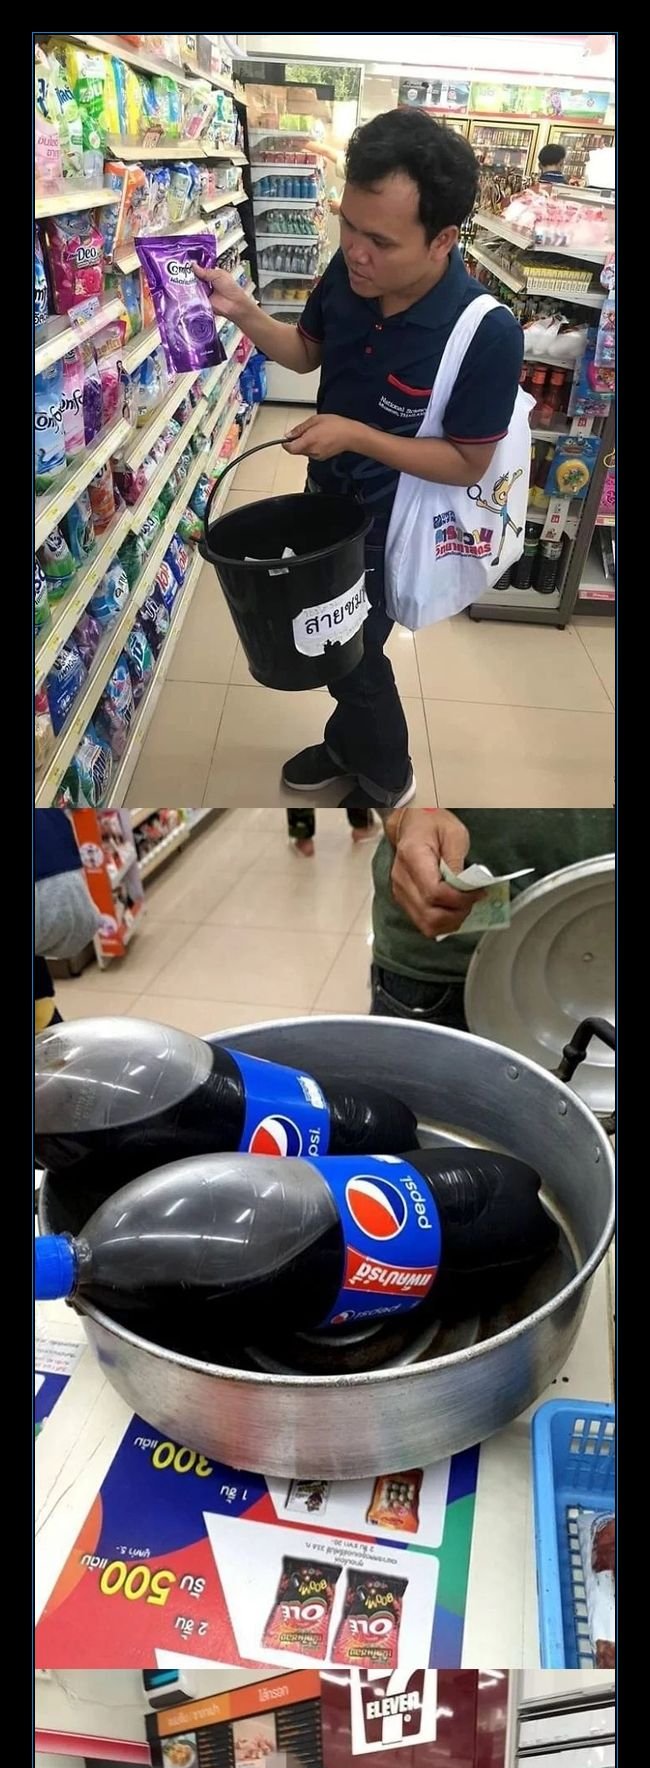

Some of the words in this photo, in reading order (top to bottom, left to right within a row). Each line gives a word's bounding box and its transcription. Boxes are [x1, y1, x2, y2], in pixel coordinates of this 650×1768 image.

[77, 247, 97, 262] Deo
[380, 396, 405, 411] National
[308, 1127, 321, 1157] psi
[400, 1175, 432, 1229] pepsi
[100, 1560, 176, 1606] 500
[180, 1574, 206, 1598] รับ
[175, 1616, 194, 1639] ชิ้น
[199, 1621, 209, 1635] 2
